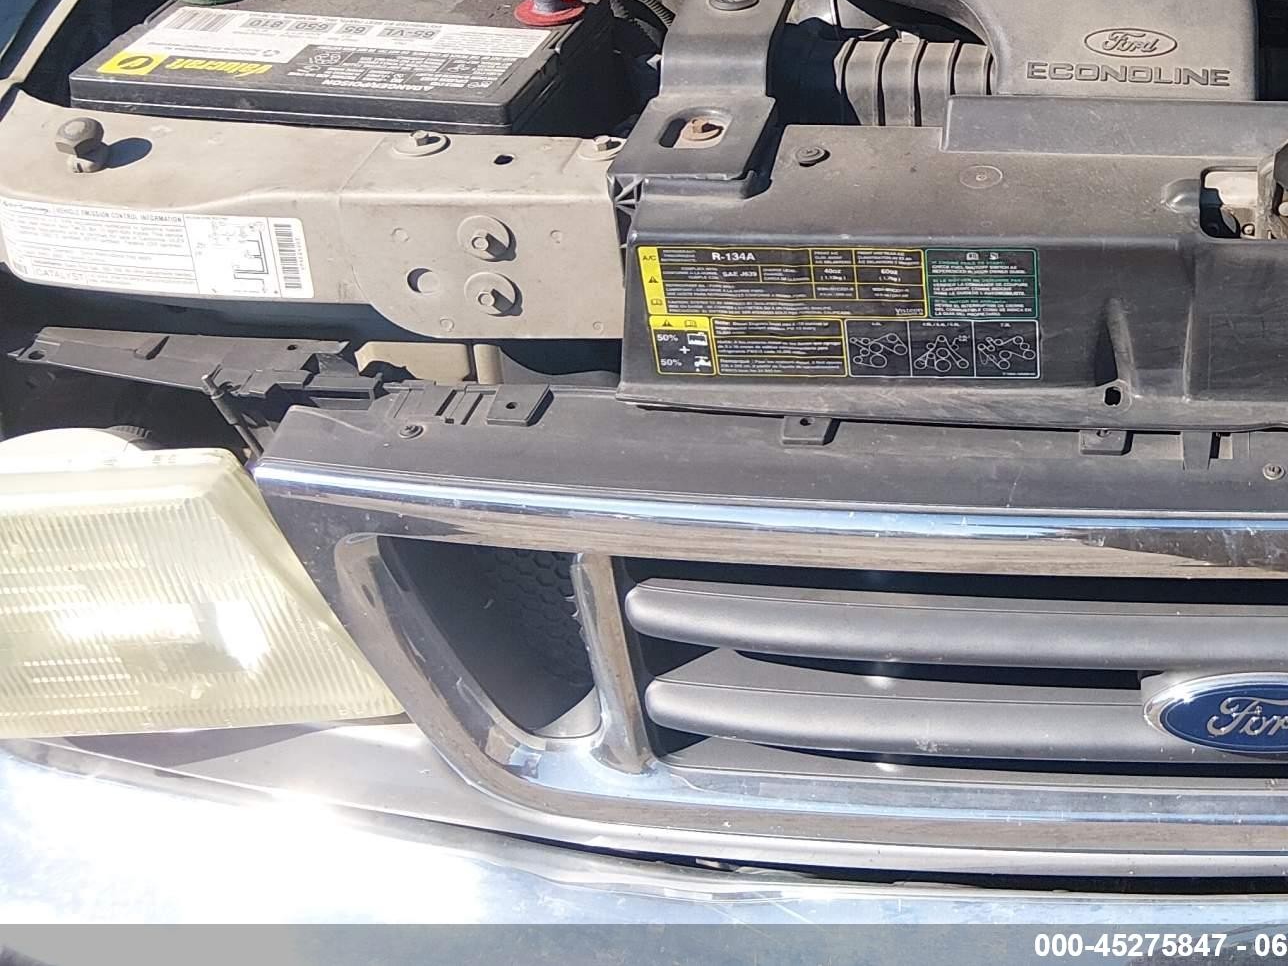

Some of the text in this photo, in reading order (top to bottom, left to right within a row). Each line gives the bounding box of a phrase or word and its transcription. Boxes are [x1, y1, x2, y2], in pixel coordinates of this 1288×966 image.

[248, 19, 436, 39] 810 650 65 65-VL
[1102, 31, 1159, 53] Ford
[164, 57, 273, 78] Valucraft
[1026, 62, 1231, 87] ECONOLINE
[711, 251, 756, 262] R-134A
[656, 333, 679, 342] 50%
[660, 358, 683, 366] 50%
